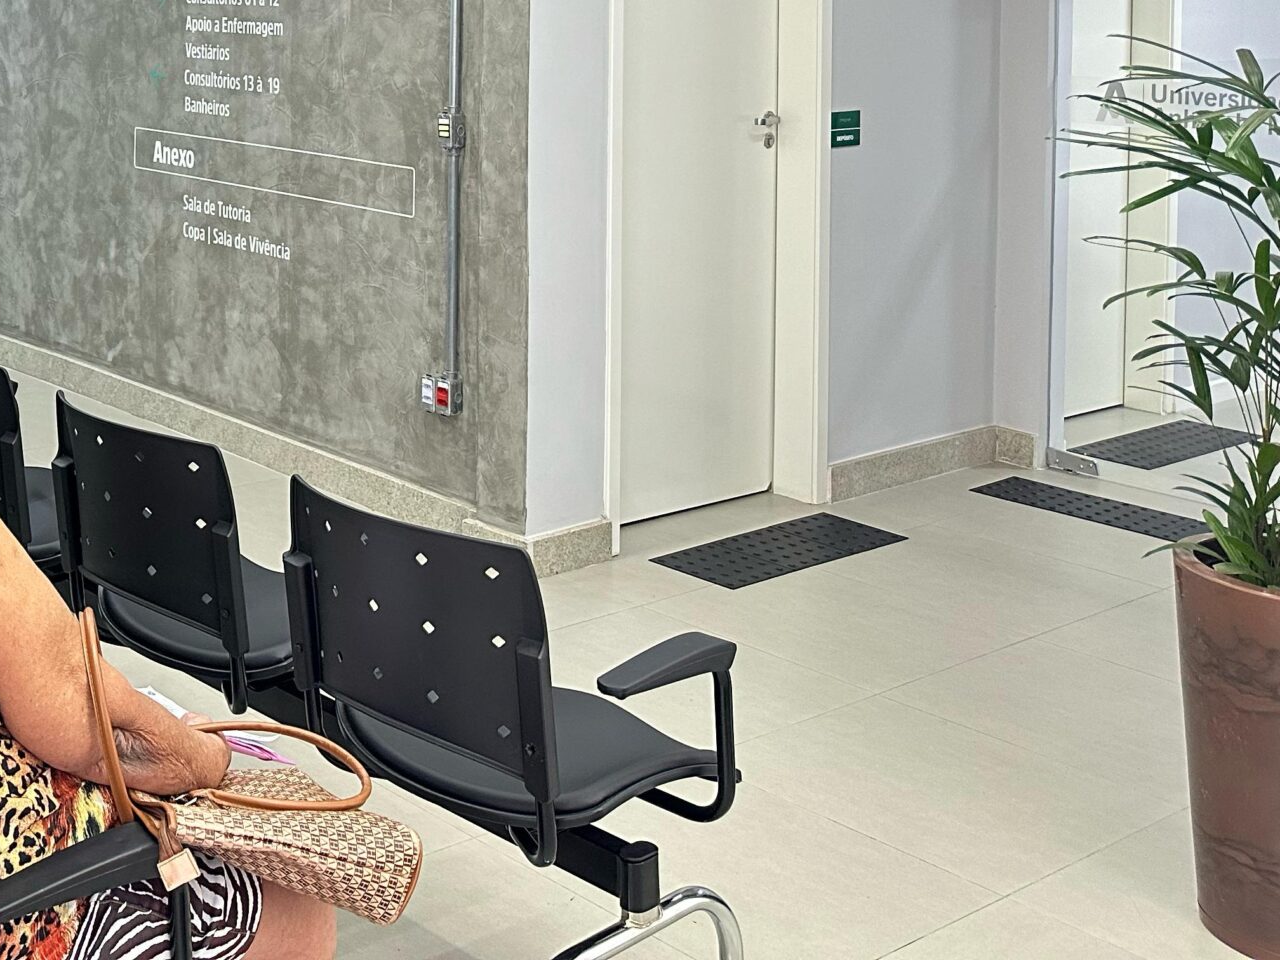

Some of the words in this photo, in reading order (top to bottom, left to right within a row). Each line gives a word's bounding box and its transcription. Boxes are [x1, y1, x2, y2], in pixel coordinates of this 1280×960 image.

[185, 16, 212, 34] Apoio
[214, 20, 220, 32] a
[222, 17, 284, 37] Enfermagem
[185, 43, 230, 61] Vestiários
[184, 69, 241, 90] Consultórios
[243, 75, 254, 91] 13
[256, 75, 263, 92] à
[267, 77, 280, 94] 19
[184, 97, 230, 116] Banheiros
[1151, 83, 1280, 109] Universi
[153, 140, 195, 169] Anexo
[183, 195, 201, 213] Sala
[204, 198, 215, 216] de
[217, 201, 251, 223] Tutoria
[183, 222, 205, 242] Copa
[213, 228, 232, 248] Sala
[235, 231, 246, 250] de
[249, 234, 290, 261] Vivência
